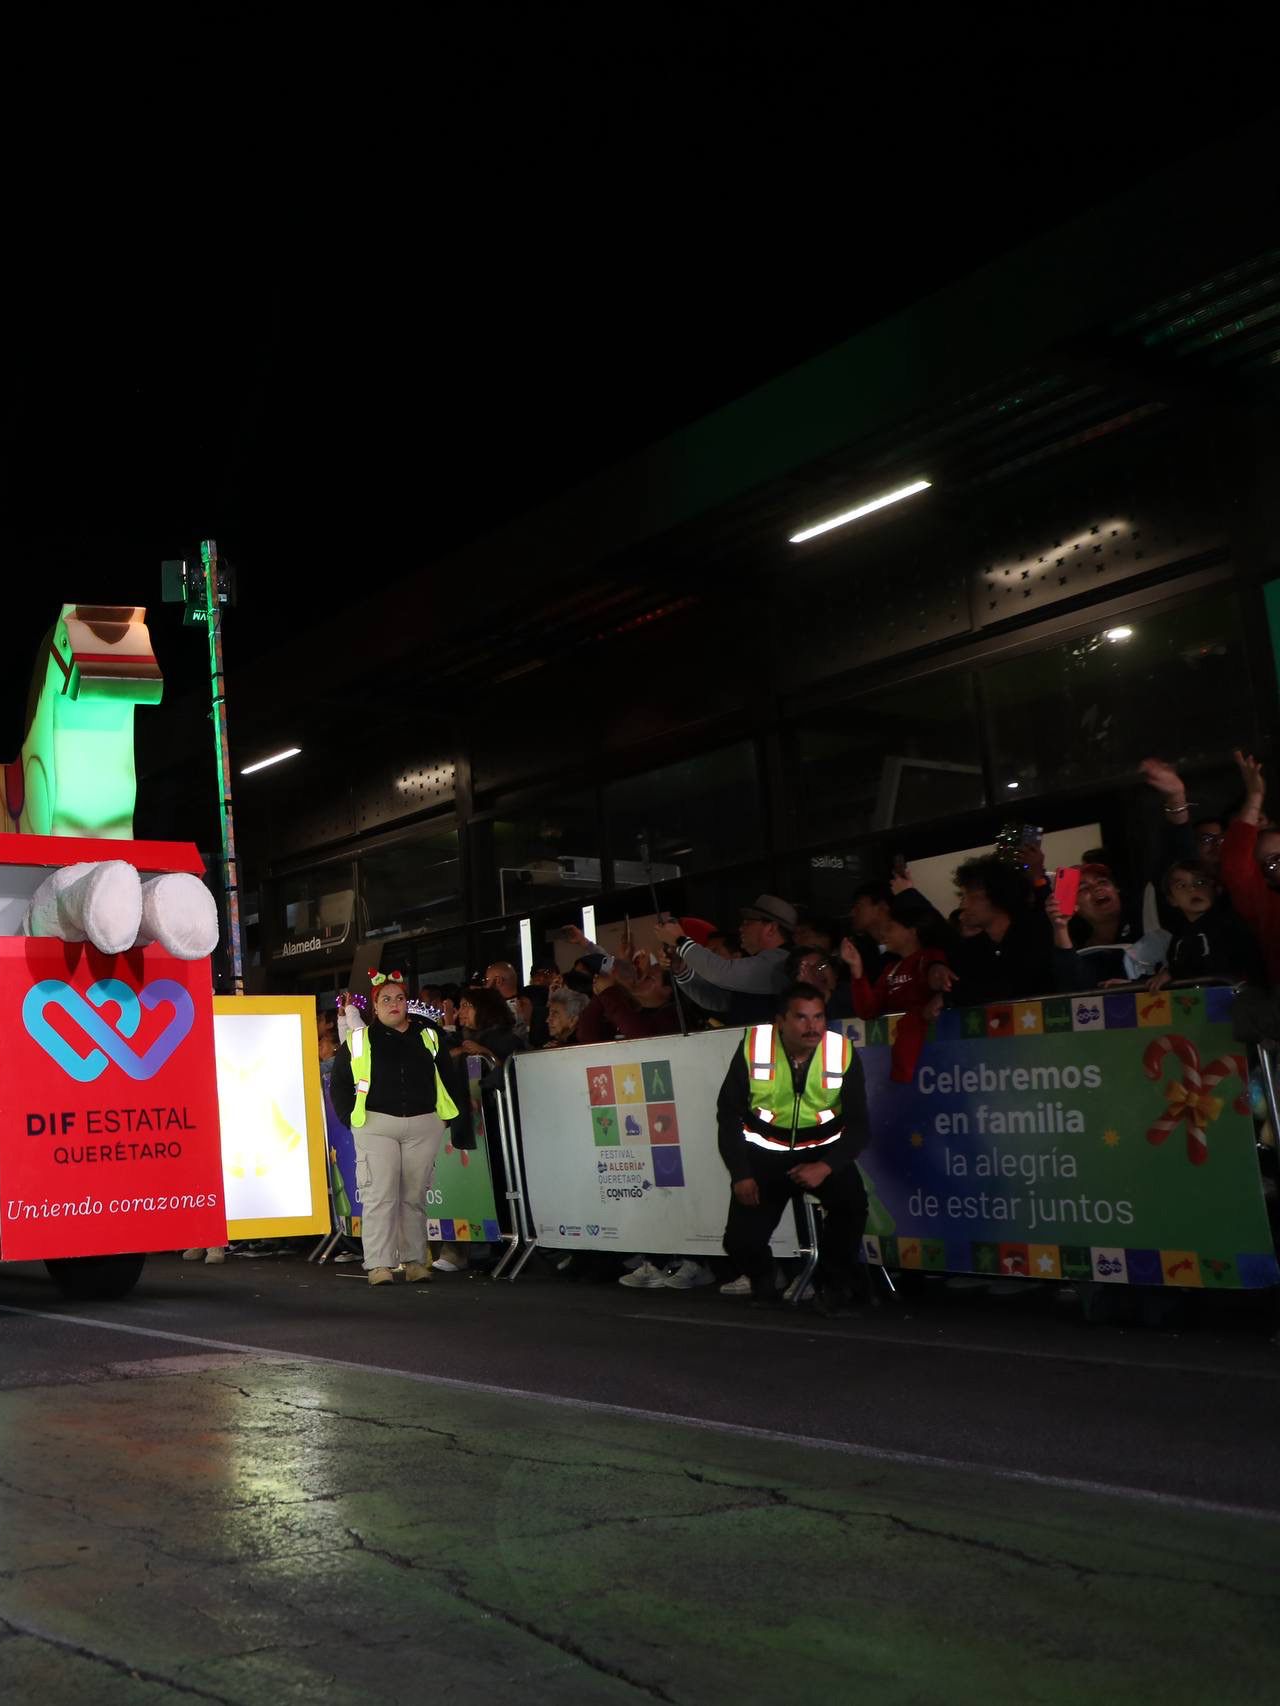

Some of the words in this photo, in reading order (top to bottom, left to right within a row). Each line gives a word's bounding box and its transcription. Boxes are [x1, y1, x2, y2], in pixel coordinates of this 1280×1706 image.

[282, 936, 321, 957] Alameda
[918, 1063, 1102, 1094] Celebremos
[27, 1112, 76, 1136] DIF
[87, 1107, 196, 1134] ESTATAL
[935, 1109, 969, 1134] en
[976, 1102, 1085, 1135] familia
[53, 1141, 182, 1165] QUERÉTARO
[600, 1149, 636, 1159] FESTIVAL
[944, 1147, 968, 1177] la
[976, 1146, 1078, 1185] alegría
[7, 1196, 103, 1220] Uniendo
[109, 1192, 217, 1214] corazones
[909, 1188, 939, 1217] de
[947, 1191, 1021, 1220] estar
[1028, 1190, 1134, 1229] juntos
